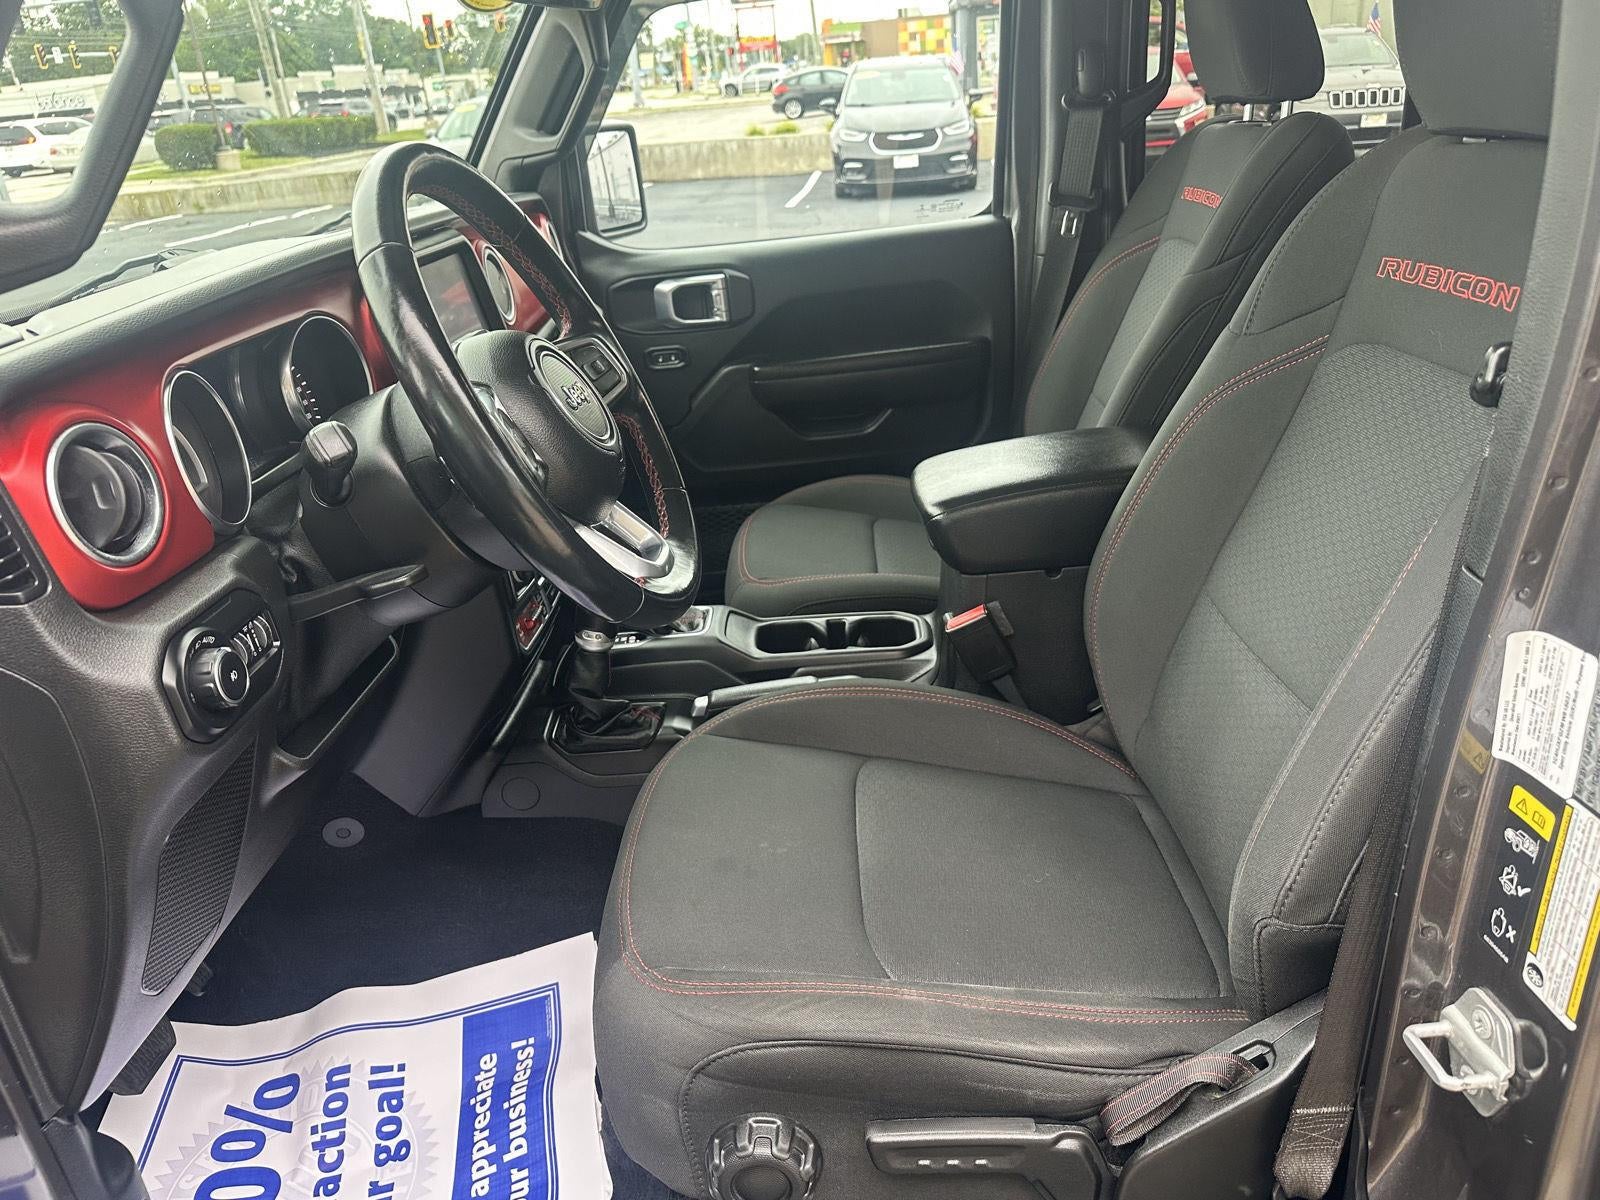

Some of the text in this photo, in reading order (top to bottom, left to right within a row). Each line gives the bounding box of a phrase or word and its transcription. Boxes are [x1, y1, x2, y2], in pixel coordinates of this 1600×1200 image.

[1181, 186, 1223, 209] RUBICON
[1376, 256, 1521, 313] RUBICON
[560, 382, 591, 411] Jeep
[310, 1064, 351, 1200] action
[367, 1063, 411, 1167] goal!
[470, 1052, 498, 1198] appreciate
[502, 1037, 535, 1163] business!
